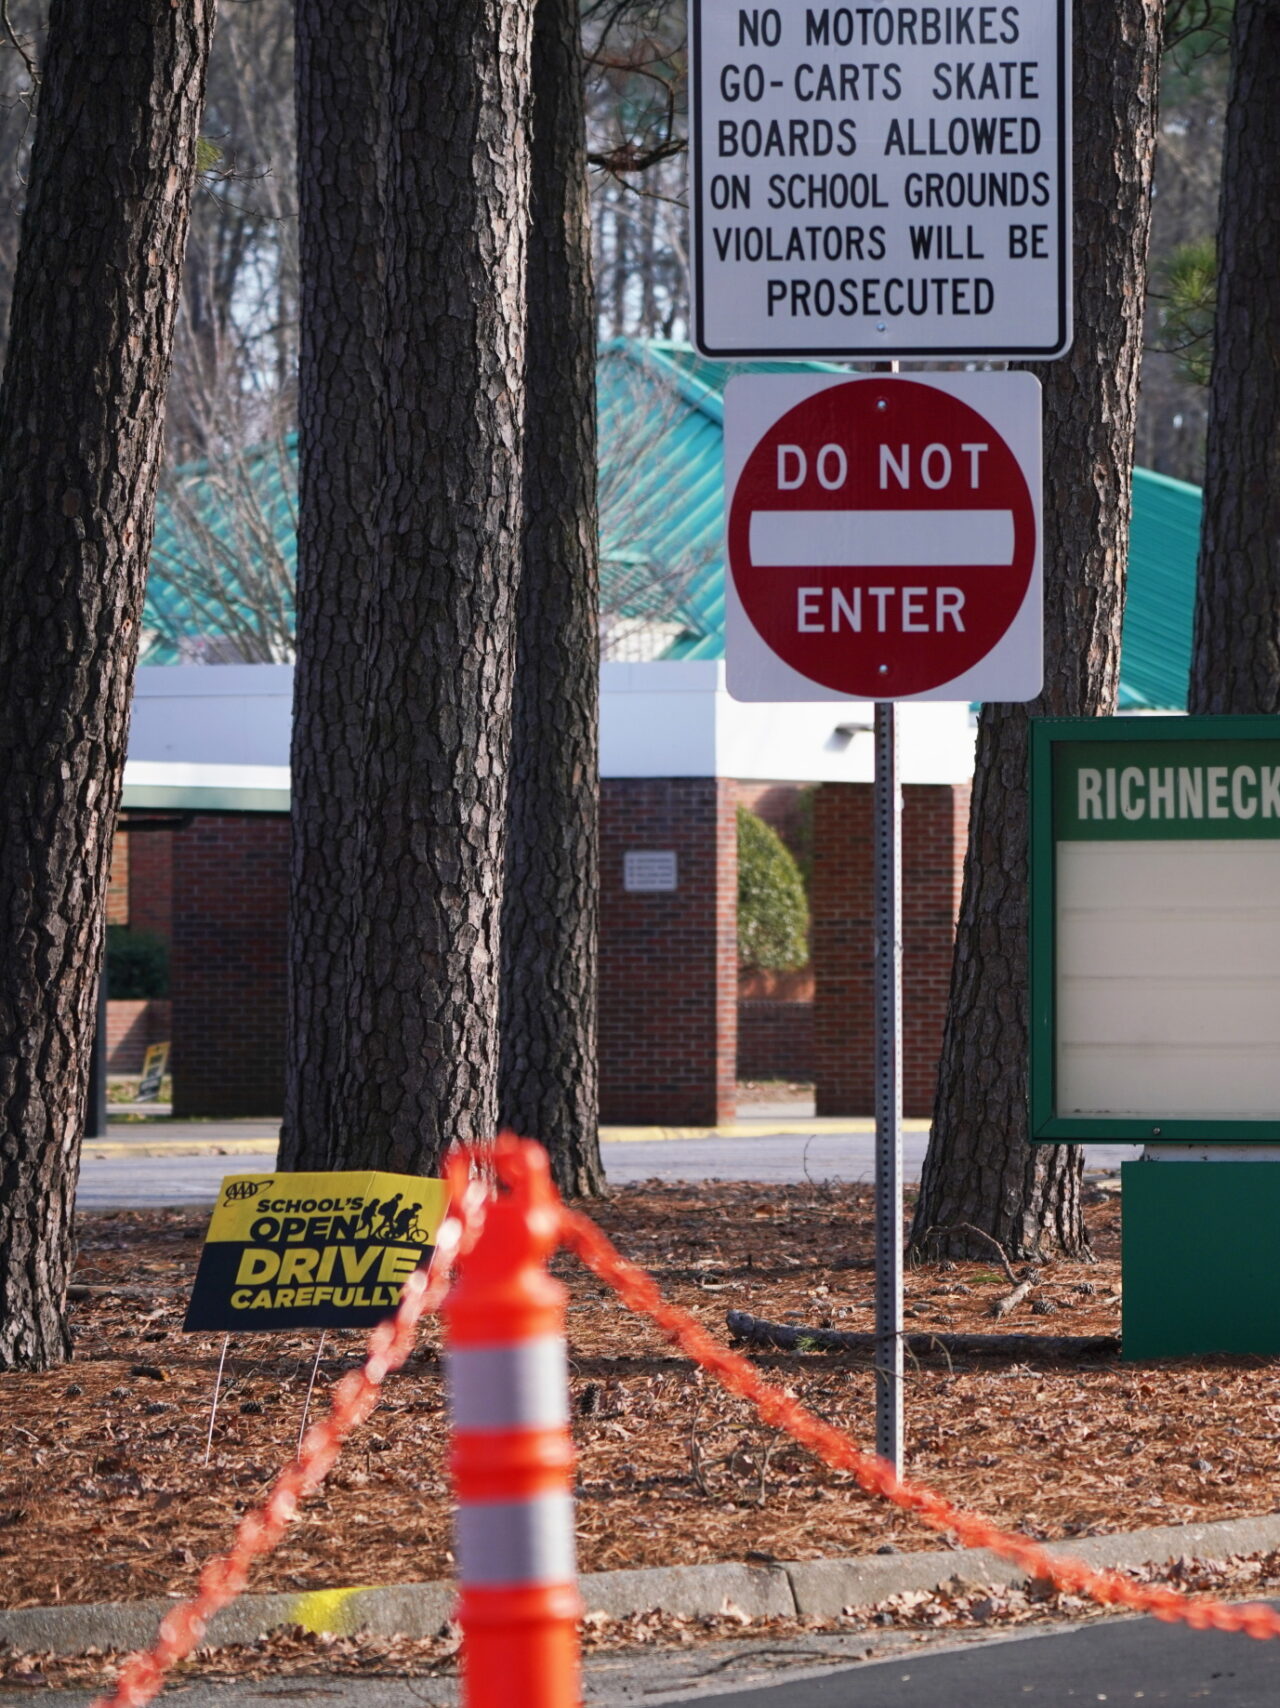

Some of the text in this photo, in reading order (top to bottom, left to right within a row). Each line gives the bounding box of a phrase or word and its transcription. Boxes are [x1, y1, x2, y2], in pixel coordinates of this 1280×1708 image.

[739, 6, 1020, 47] NO MOTORBIKES
[720, 61, 1039, 102] GO-CARTS SKATE
[718, 117, 1041, 158] BOARDS ALLOWED
[710, 172, 1050, 210] ON SCHOOL GROUNDS
[713, 224, 1049, 262] VIOLATORS WILL BE
[767, 278, 994, 317] PROSECUTED
[777, 443, 989, 490] DO NOT
[797, 587, 966, 633] ENTER
[227, 1181, 257, 1199] AAA
[249, 1214, 360, 1243] OPEN
[235, 1245, 422, 1285] DRIVE
[230, 1286, 403, 1310] CAREFULLY
